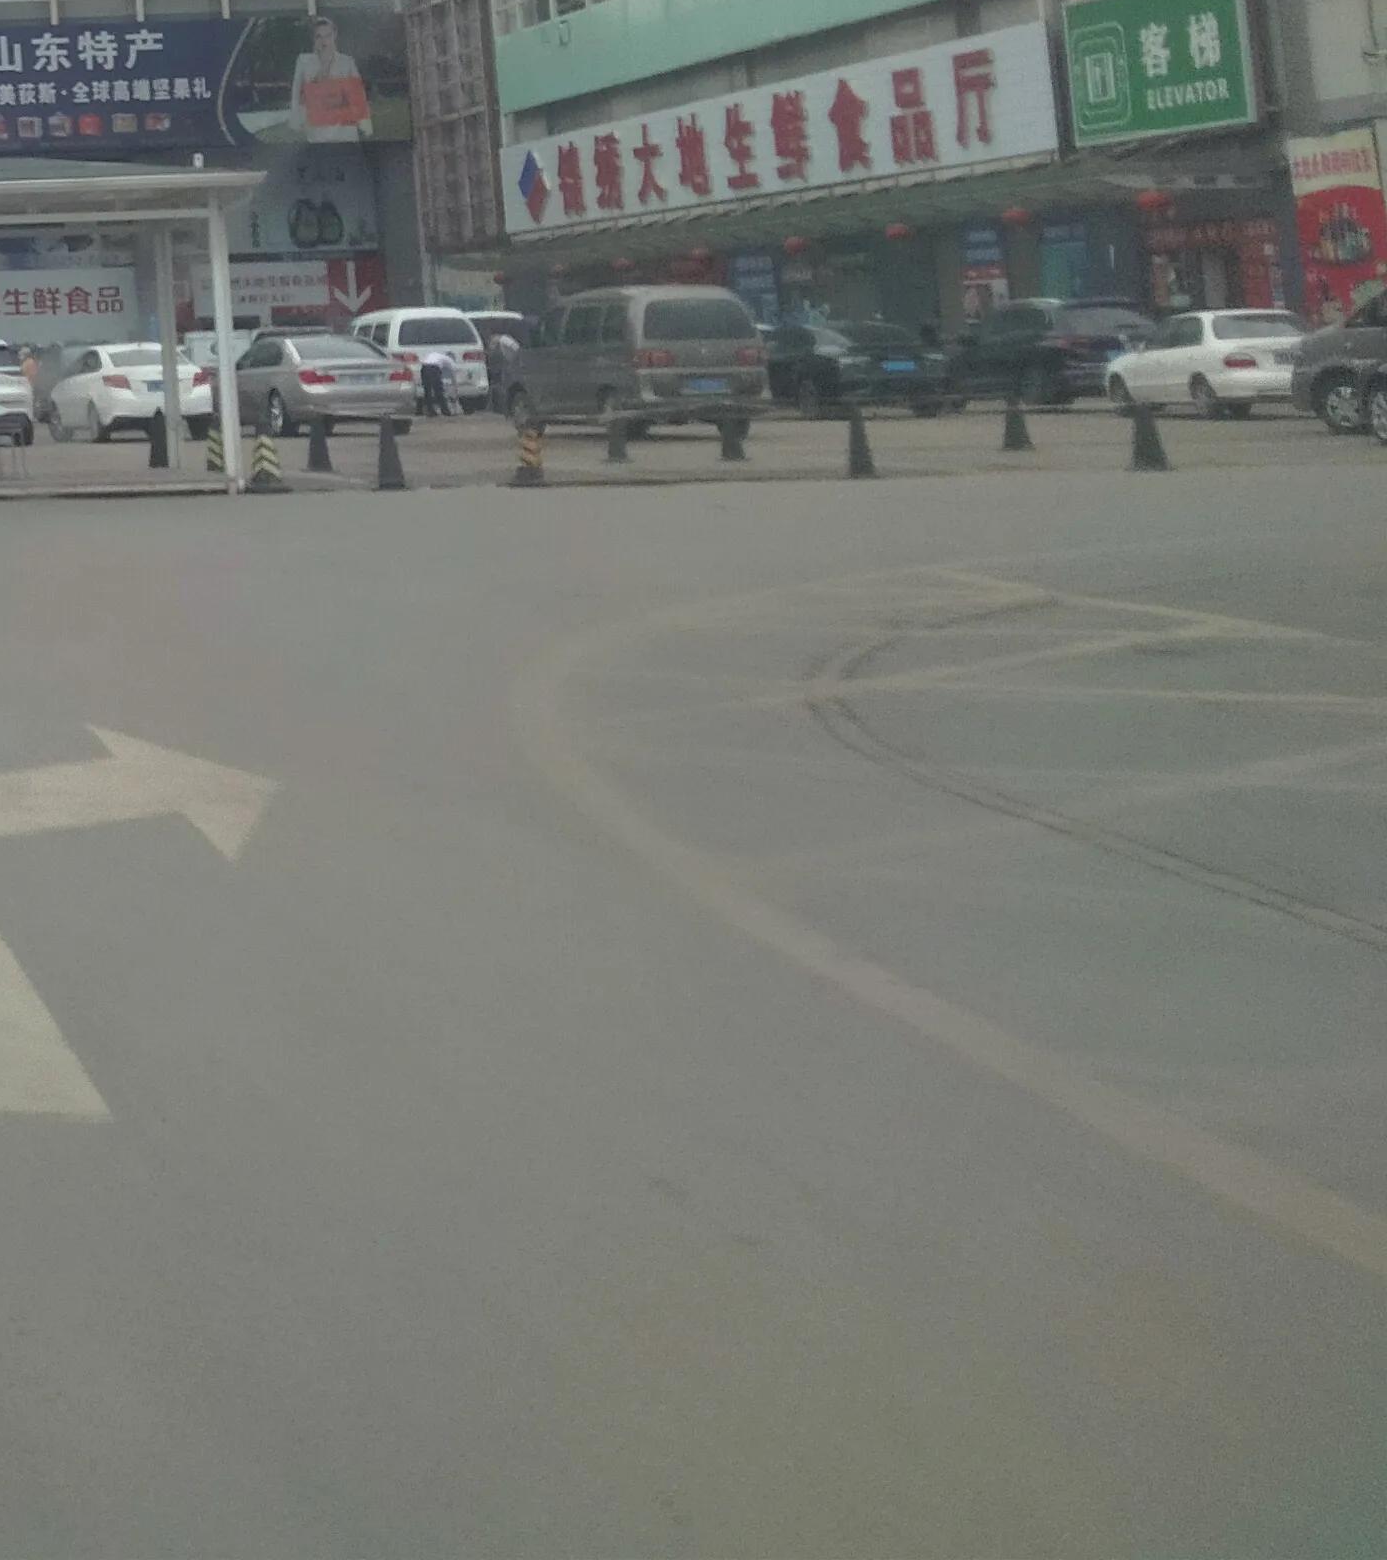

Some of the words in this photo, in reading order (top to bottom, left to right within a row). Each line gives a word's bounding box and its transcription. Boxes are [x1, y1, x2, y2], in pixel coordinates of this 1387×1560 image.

[1138, 12, 1222, 79] 客梯
[1147, 78, 1229, 109] ELEVATOR
[558, 49, 997, 217] 锦绣大地生鲜食品厅
